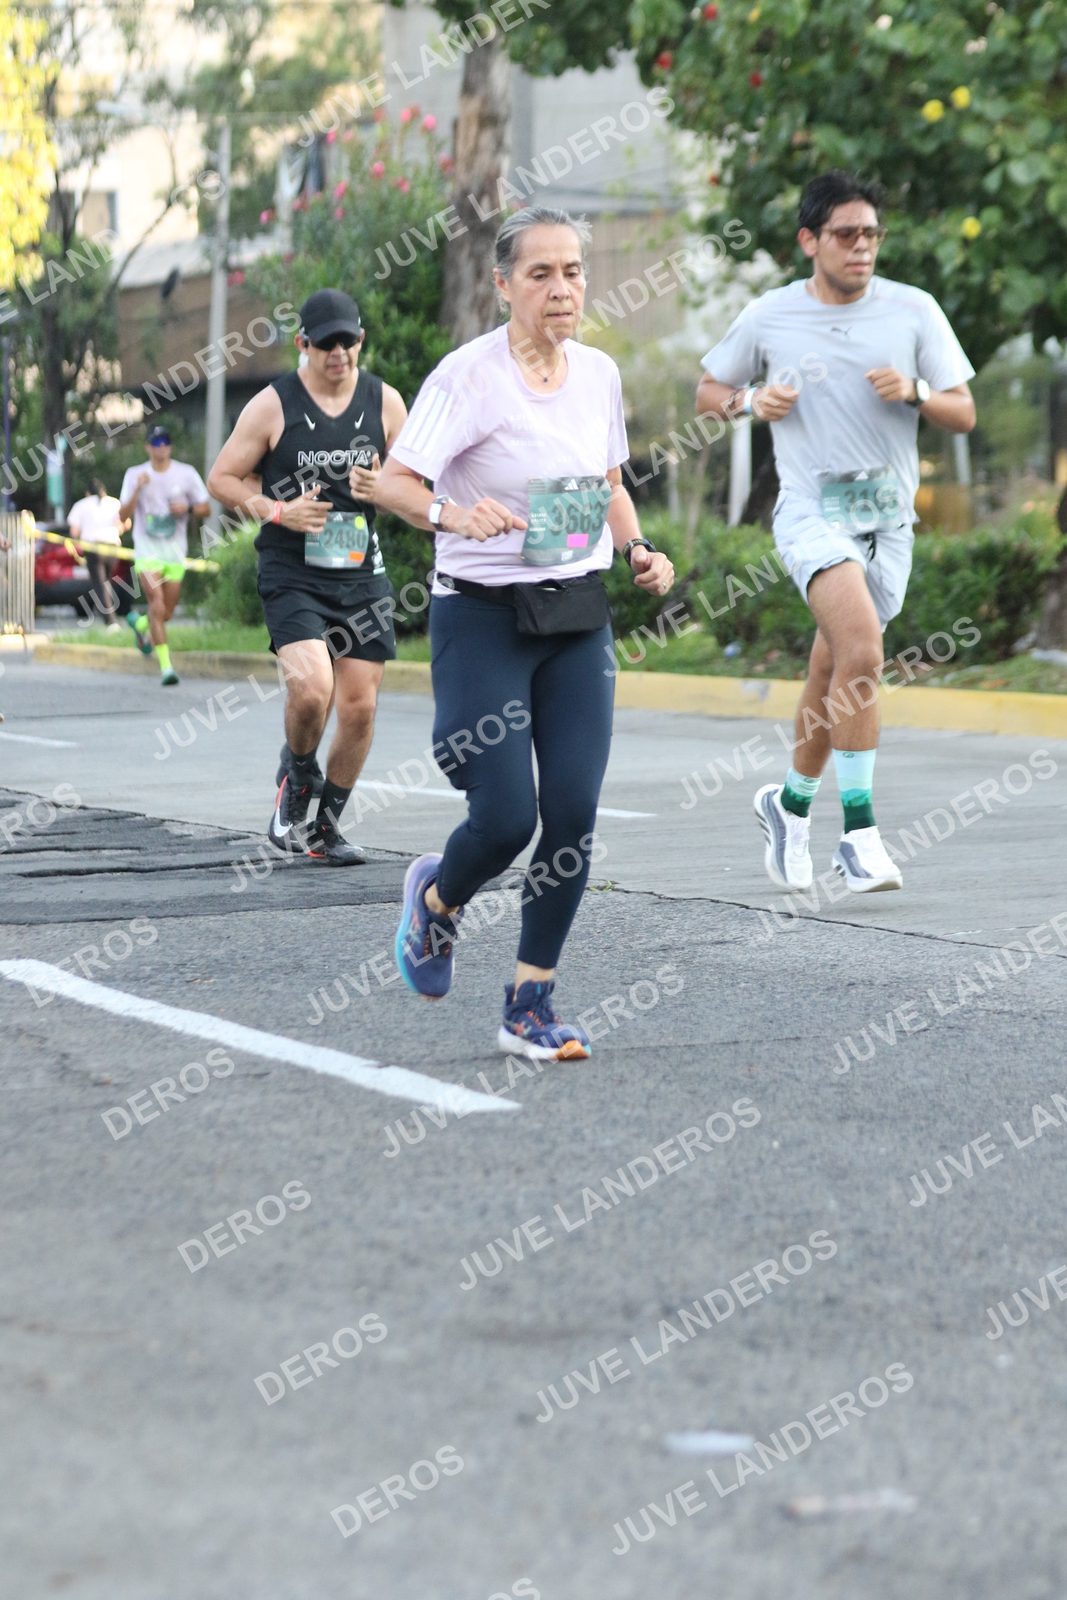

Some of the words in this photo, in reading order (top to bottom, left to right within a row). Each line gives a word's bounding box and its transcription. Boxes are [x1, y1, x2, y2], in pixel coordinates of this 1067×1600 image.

[297, 449, 369, 467] NOCTA
[550, 501, 605, 536] 3663
[324, 528, 367, 550] 2480
